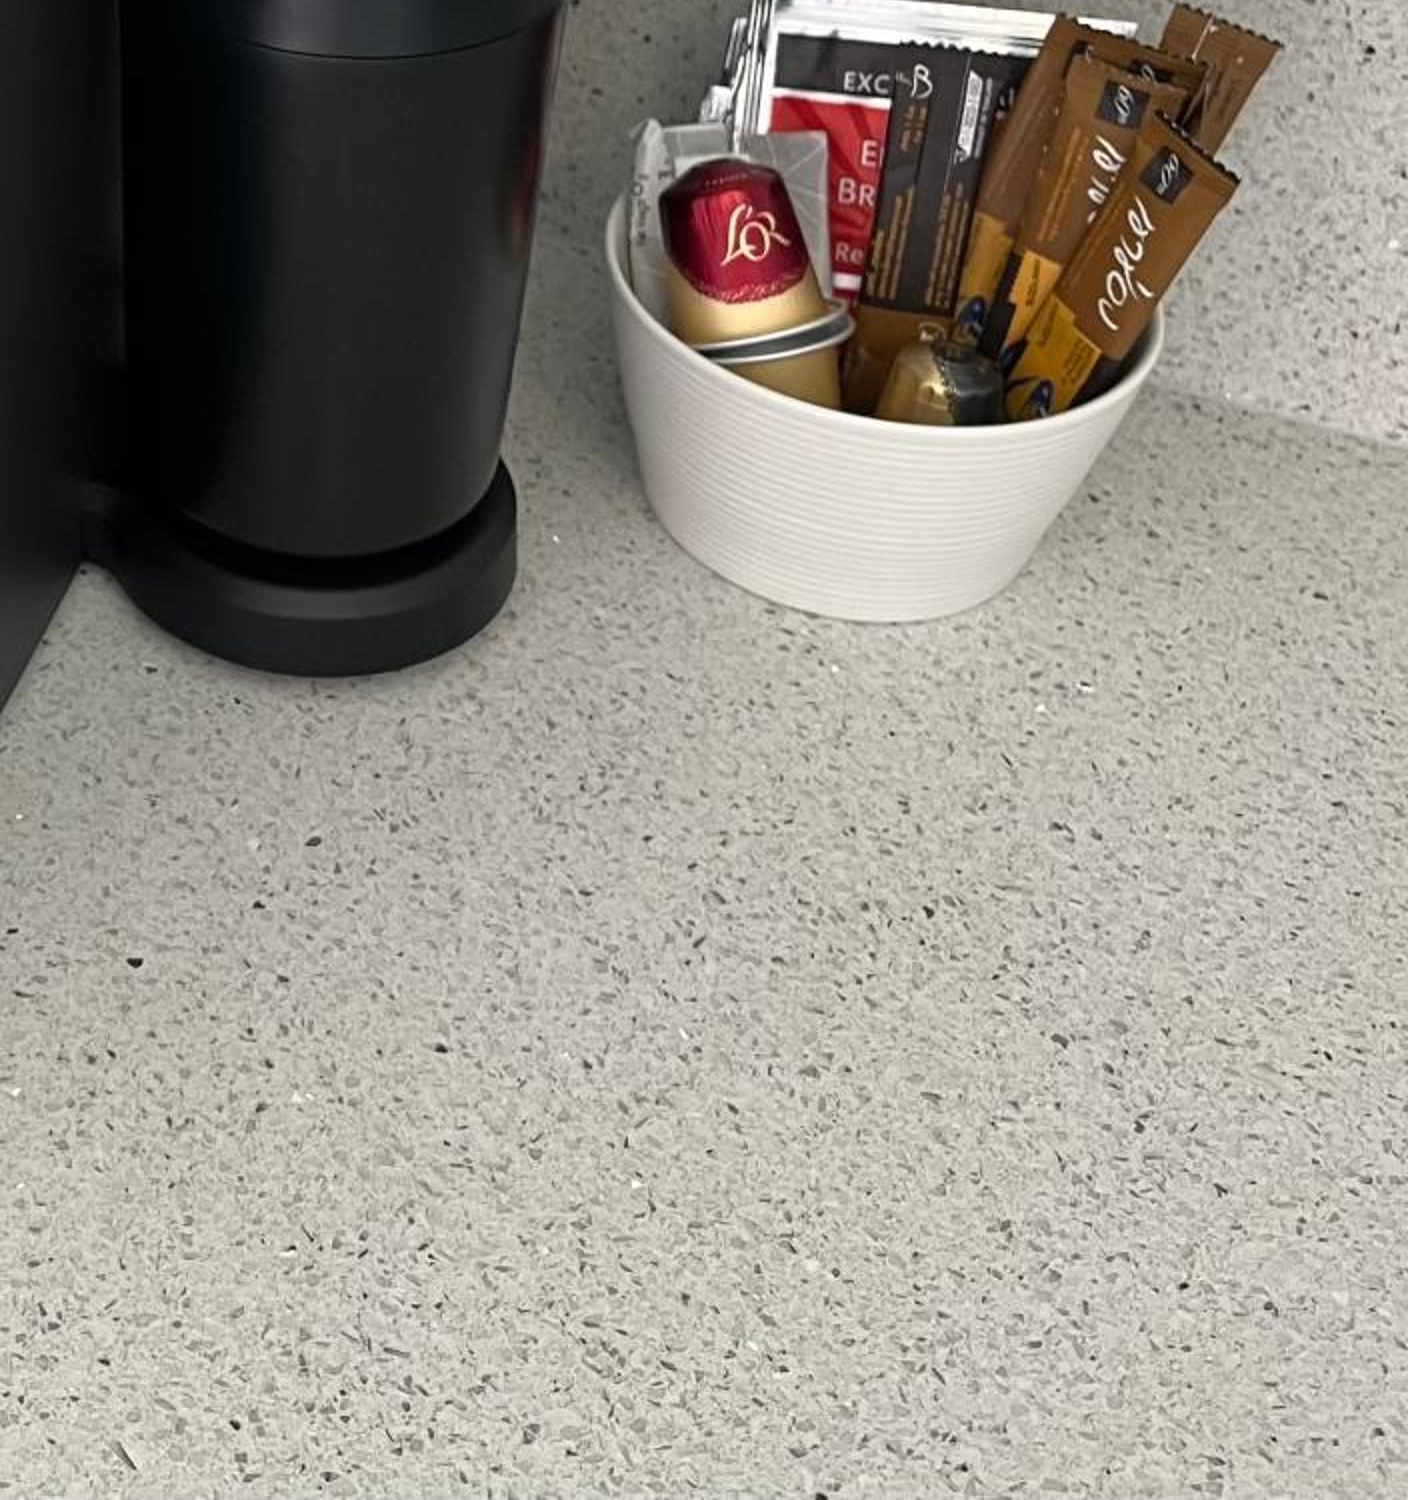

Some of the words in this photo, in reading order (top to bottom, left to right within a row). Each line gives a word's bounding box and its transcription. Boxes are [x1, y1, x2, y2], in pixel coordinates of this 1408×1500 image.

[843, 70, 891, 93] EXC
[837, 176, 876, 207] BR
[719, 203, 791, 267] L'OR
[834, 241, 865, 265] Re
